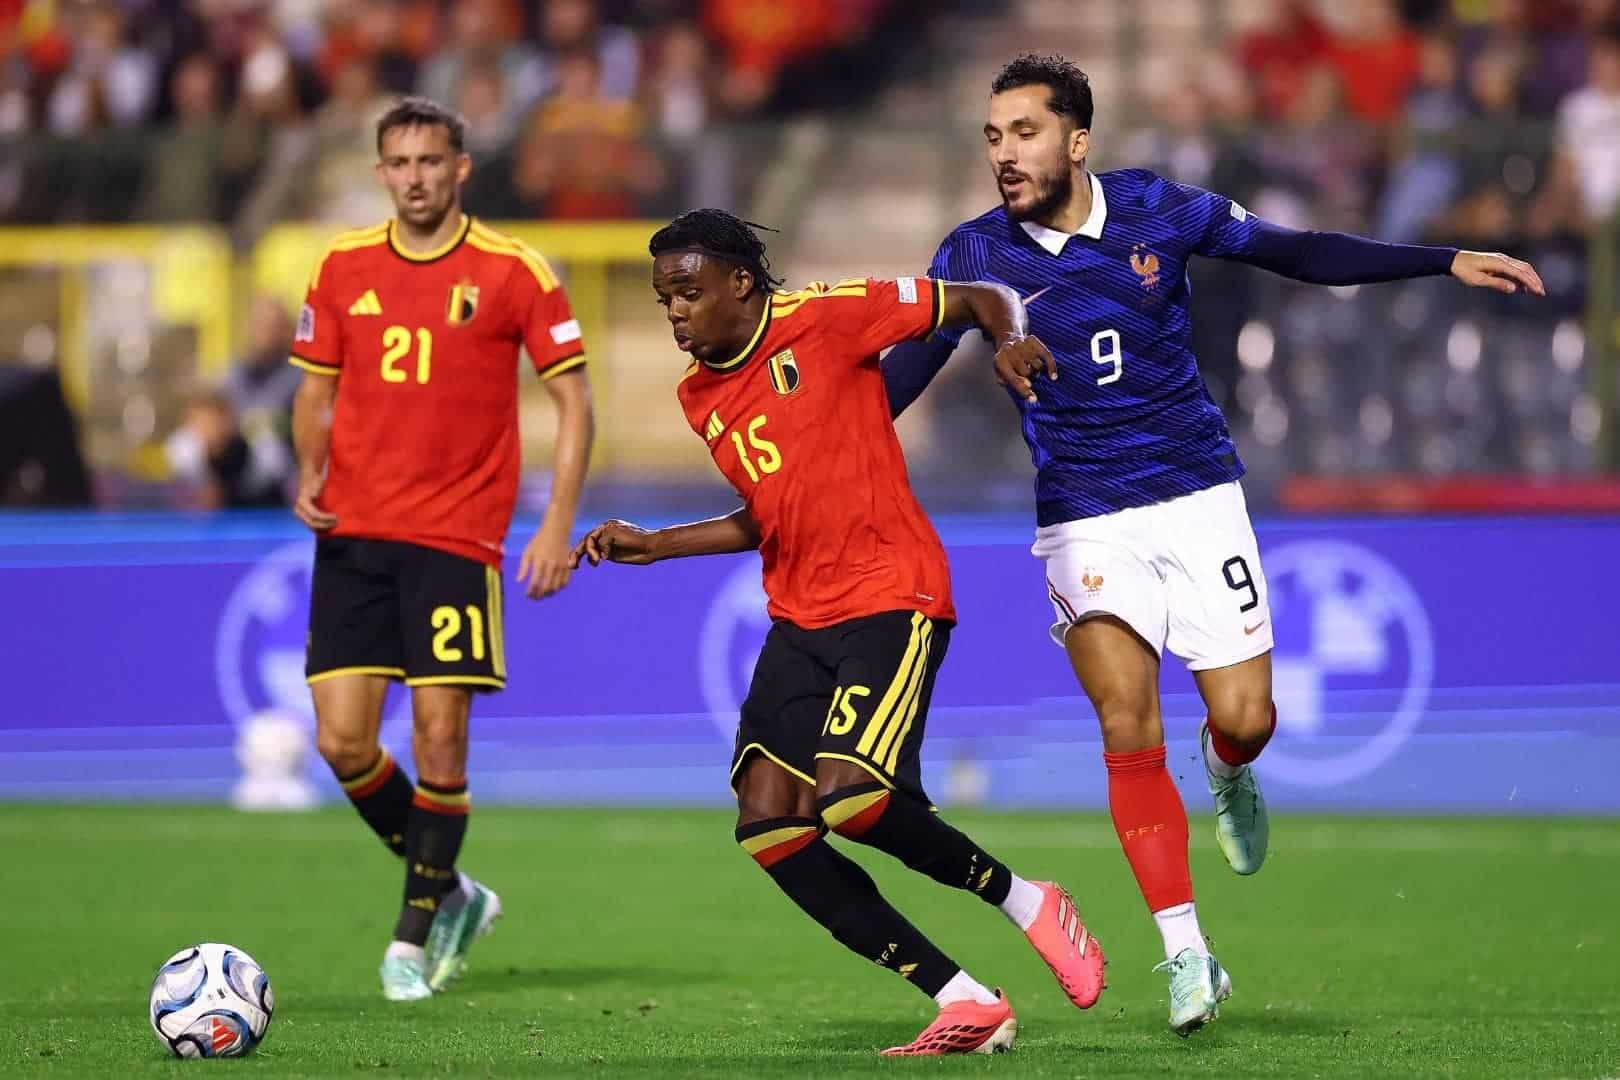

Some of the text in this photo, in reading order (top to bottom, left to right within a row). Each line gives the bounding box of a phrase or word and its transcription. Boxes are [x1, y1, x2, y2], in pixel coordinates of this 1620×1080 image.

[381, 326, 433, 384] 21
[1090, 328, 1123, 386] 9
[731, 414, 782, 483] 15
[1222, 555, 1258, 613] 9
[431, 604, 485, 662] 21
